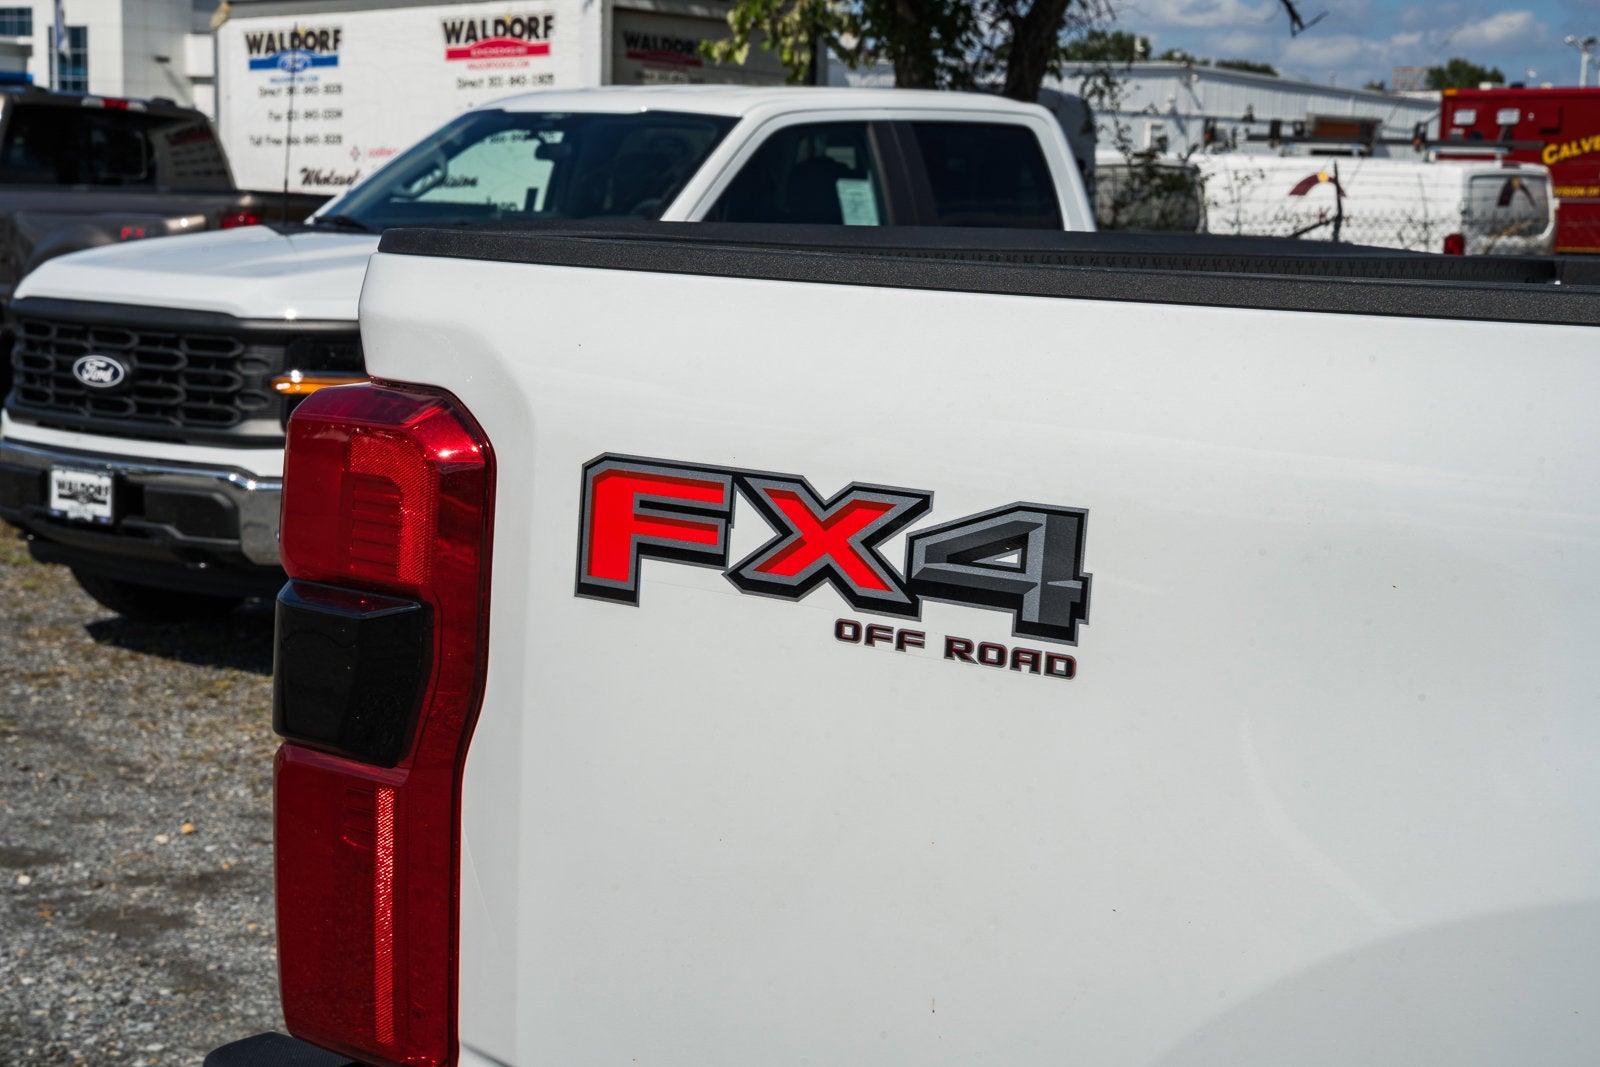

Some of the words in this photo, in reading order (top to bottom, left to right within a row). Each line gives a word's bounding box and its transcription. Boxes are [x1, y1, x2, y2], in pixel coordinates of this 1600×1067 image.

[245, 29, 342, 54] WALDORF
[443, 15, 554, 44] WALDORF
[623, 30, 703, 57] WALDOR
[81, 359, 115, 382] Ford
[574, 452, 1093, 647] FX4
[834, 618, 926, 653] OFF
[944, 634, 1078, 681] ROAD
